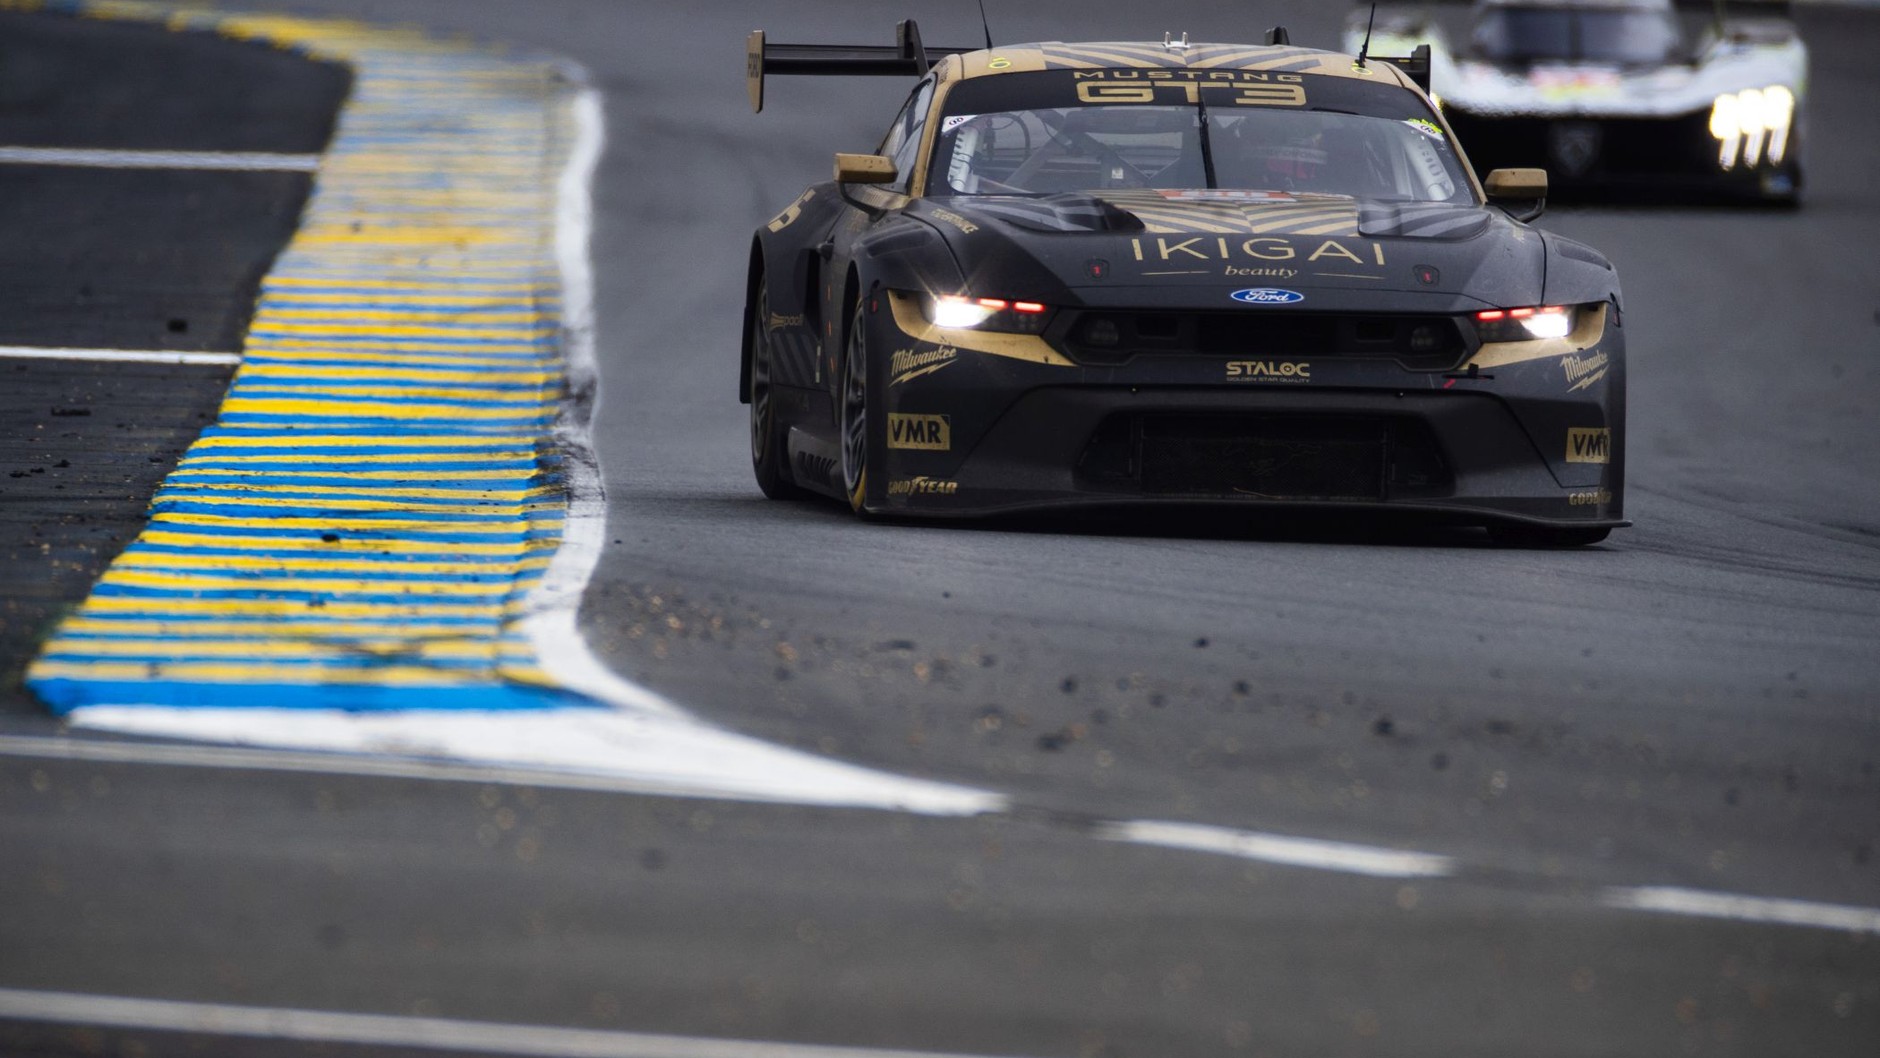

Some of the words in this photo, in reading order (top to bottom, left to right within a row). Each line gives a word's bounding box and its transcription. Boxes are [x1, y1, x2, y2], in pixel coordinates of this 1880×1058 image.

[1073, 71, 1303, 82] MUSTANG
[1076, 81, 1307, 106] GT3
[1131, 237, 1386, 266] IKIGAI
[1224, 265, 1298, 279] beauty
[1244, 290, 1290, 302] Ford
[890, 345, 957, 377] Milwaukee
[1225, 361, 1310, 377] STALOC
[1560, 349, 1608, 383] Milwaukee
[891, 419, 942, 444] VMR
